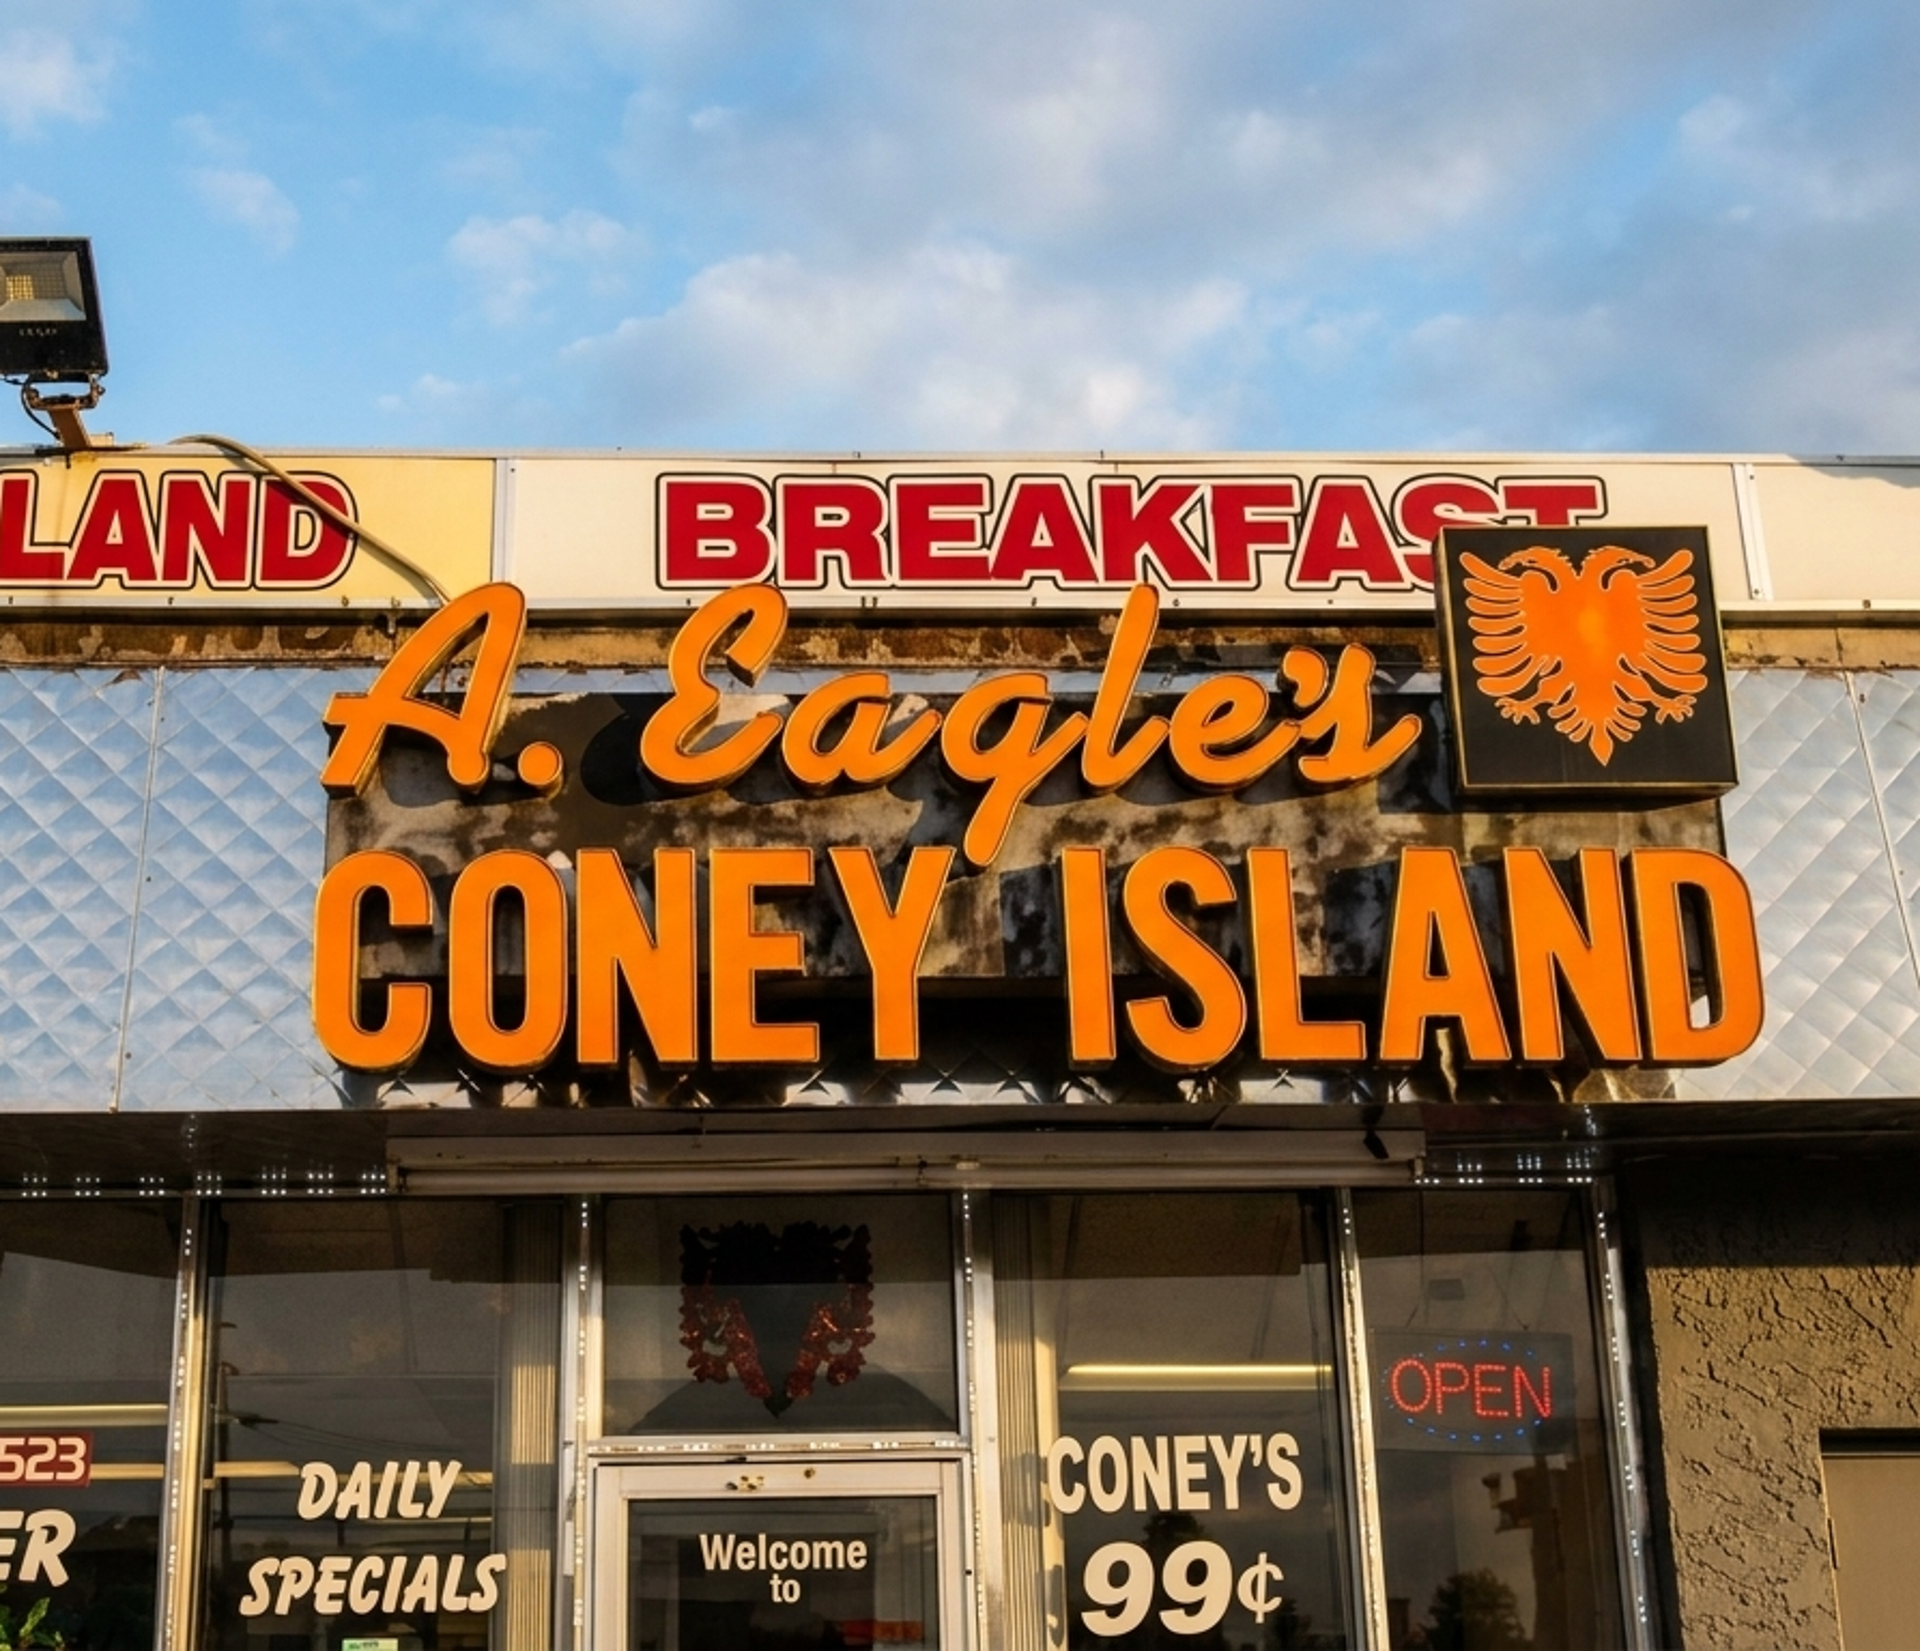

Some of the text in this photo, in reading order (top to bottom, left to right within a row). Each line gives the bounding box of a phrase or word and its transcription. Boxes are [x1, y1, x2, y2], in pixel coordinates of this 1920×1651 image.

[0, 469, 358, 591] LAND
[655, 472, 1609, 591] BREAKFAST
[320, 582, 1422, 868] A. Eagle's
[312, 846, 1765, 1070] CONEY ISLAND
[1390, 1358, 1552, 1418] OPEN
[297, 1460, 462, 1520] DAILY
[1049, 1432, 1303, 1514] CONEY'S
[239, 1553, 506, 1616] SPECIALS
[699, 1533, 867, 1571] Welcome
[769, 1573, 801, 1603] to
[1081, 1540, 1284, 1637] 99¢
